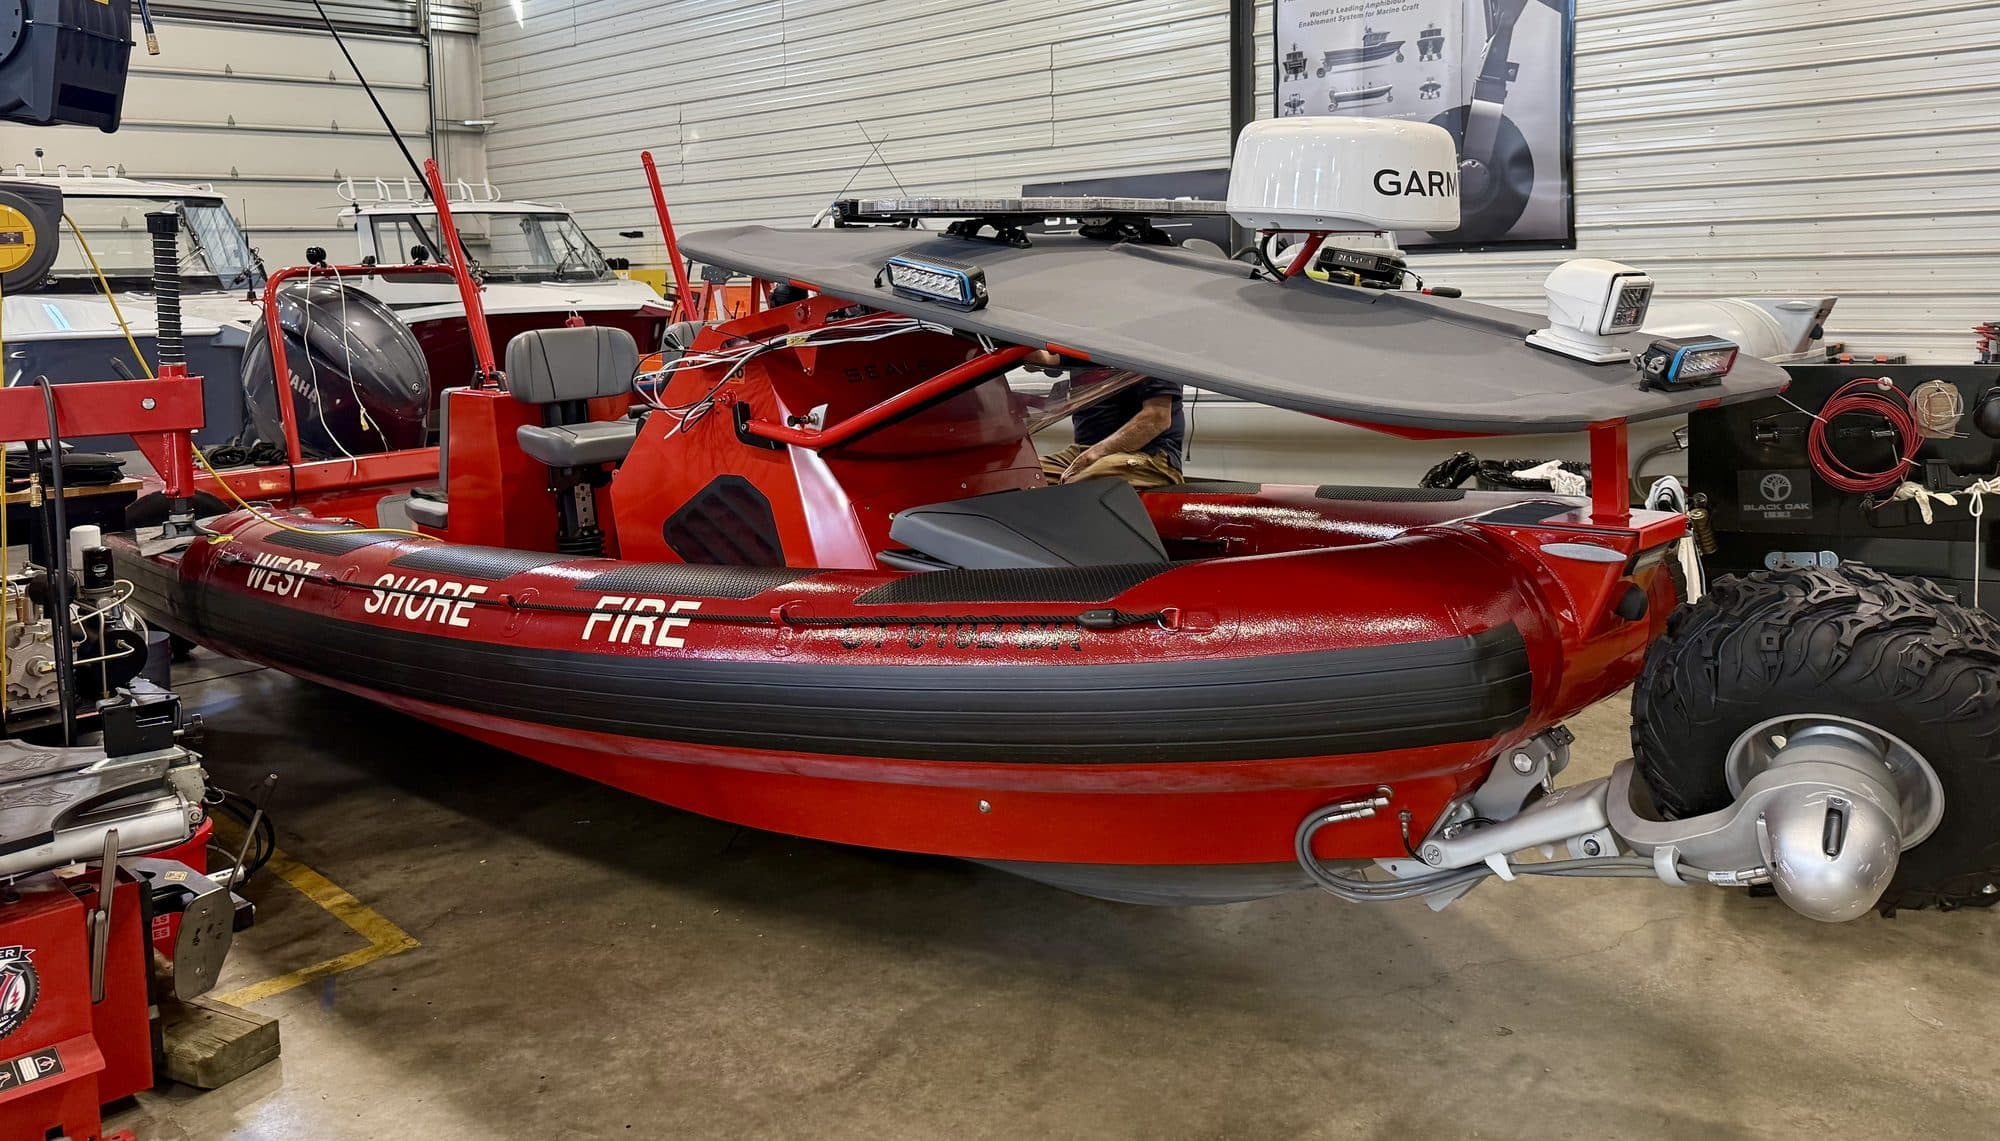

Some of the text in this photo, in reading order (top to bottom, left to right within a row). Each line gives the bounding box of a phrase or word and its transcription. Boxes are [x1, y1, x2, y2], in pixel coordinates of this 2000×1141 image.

[1298, 17, 1337, 28] Enablement
[1337, 13, 1364, 22] System
[1376, 8, 1400, 16] Marine
[1401, 3, 1420, 11] Craft
[1309, 8, 1335, 18] World's
[1335, 4, 1364, 14] Leading
[288, 368, 317, 403] AHA
[246, 552, 702, 648] WEST SHORE FIRE
